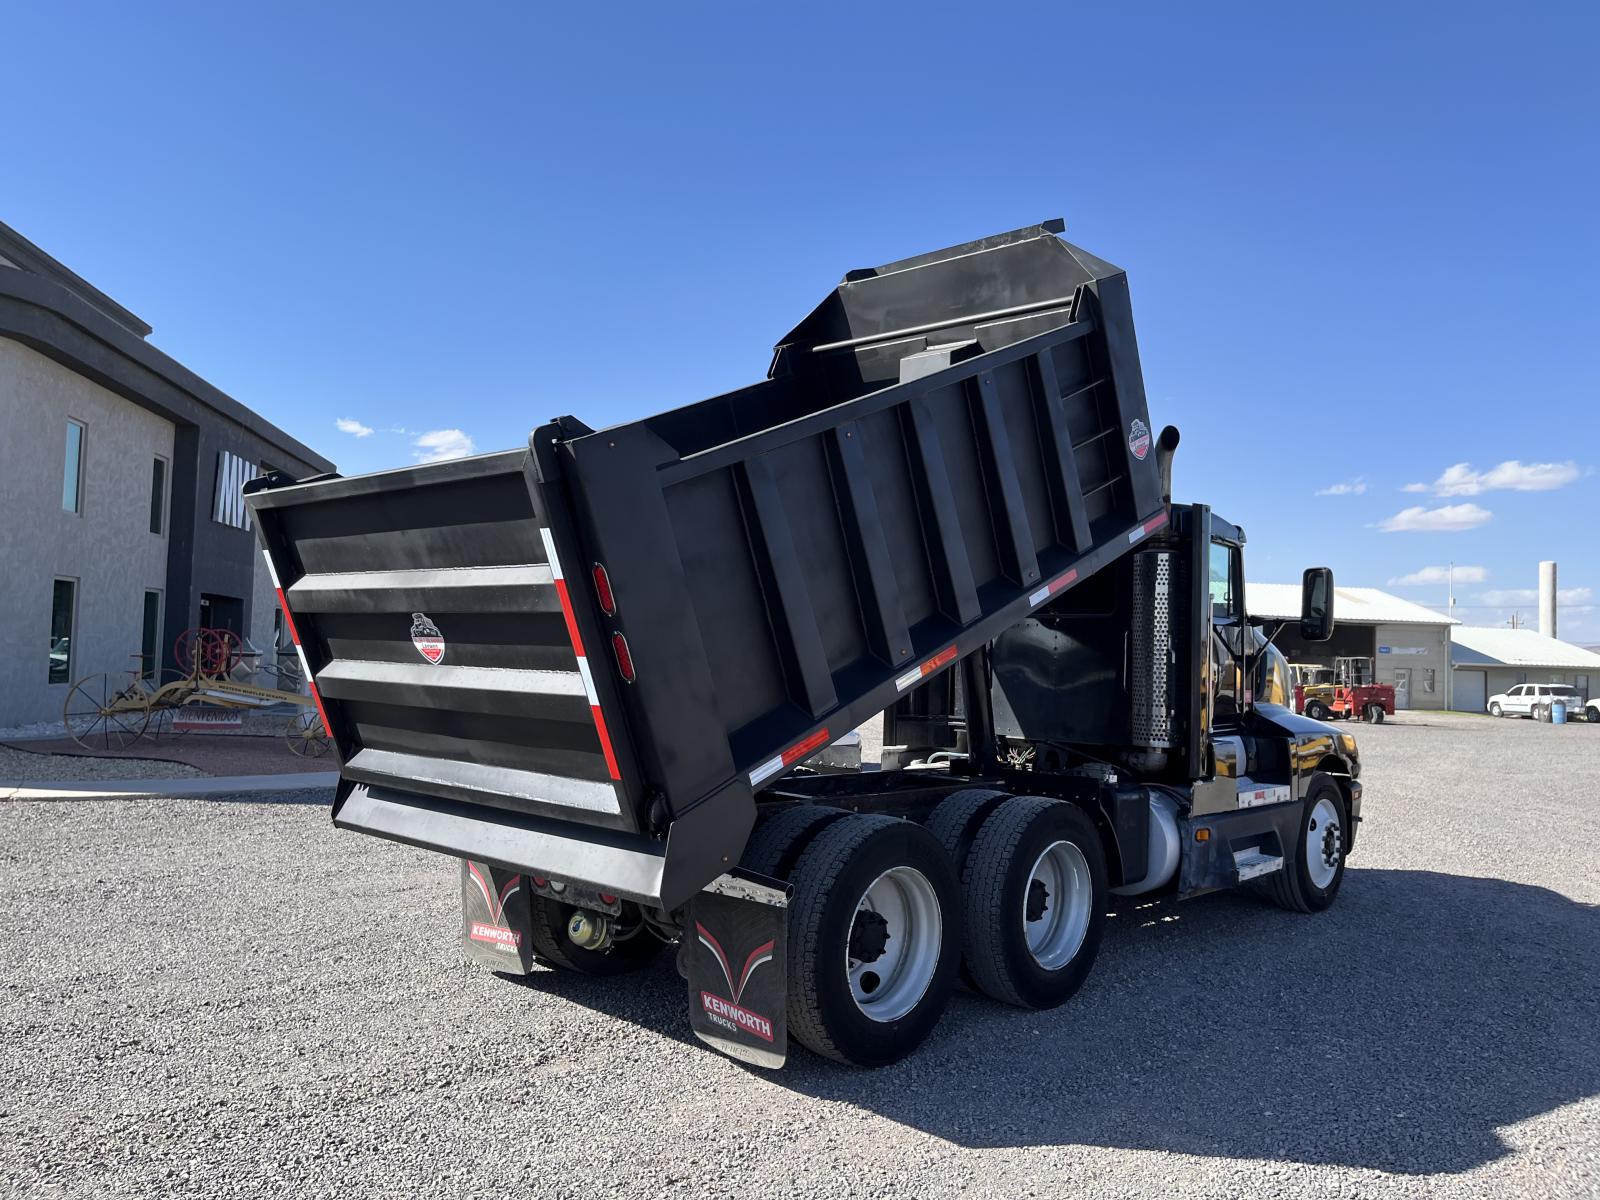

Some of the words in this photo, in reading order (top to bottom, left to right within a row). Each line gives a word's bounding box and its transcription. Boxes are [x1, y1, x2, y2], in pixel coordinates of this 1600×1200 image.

[179, 708, 240, 721] BIENVENIDOS
[472, 924, 520, 944] KENWORTH
[495, 942, 518, 953] TRUCKS
[703, 994, 771, 1037] KENWORTH
[707, 1011, 737, 1032] TRUCKS
